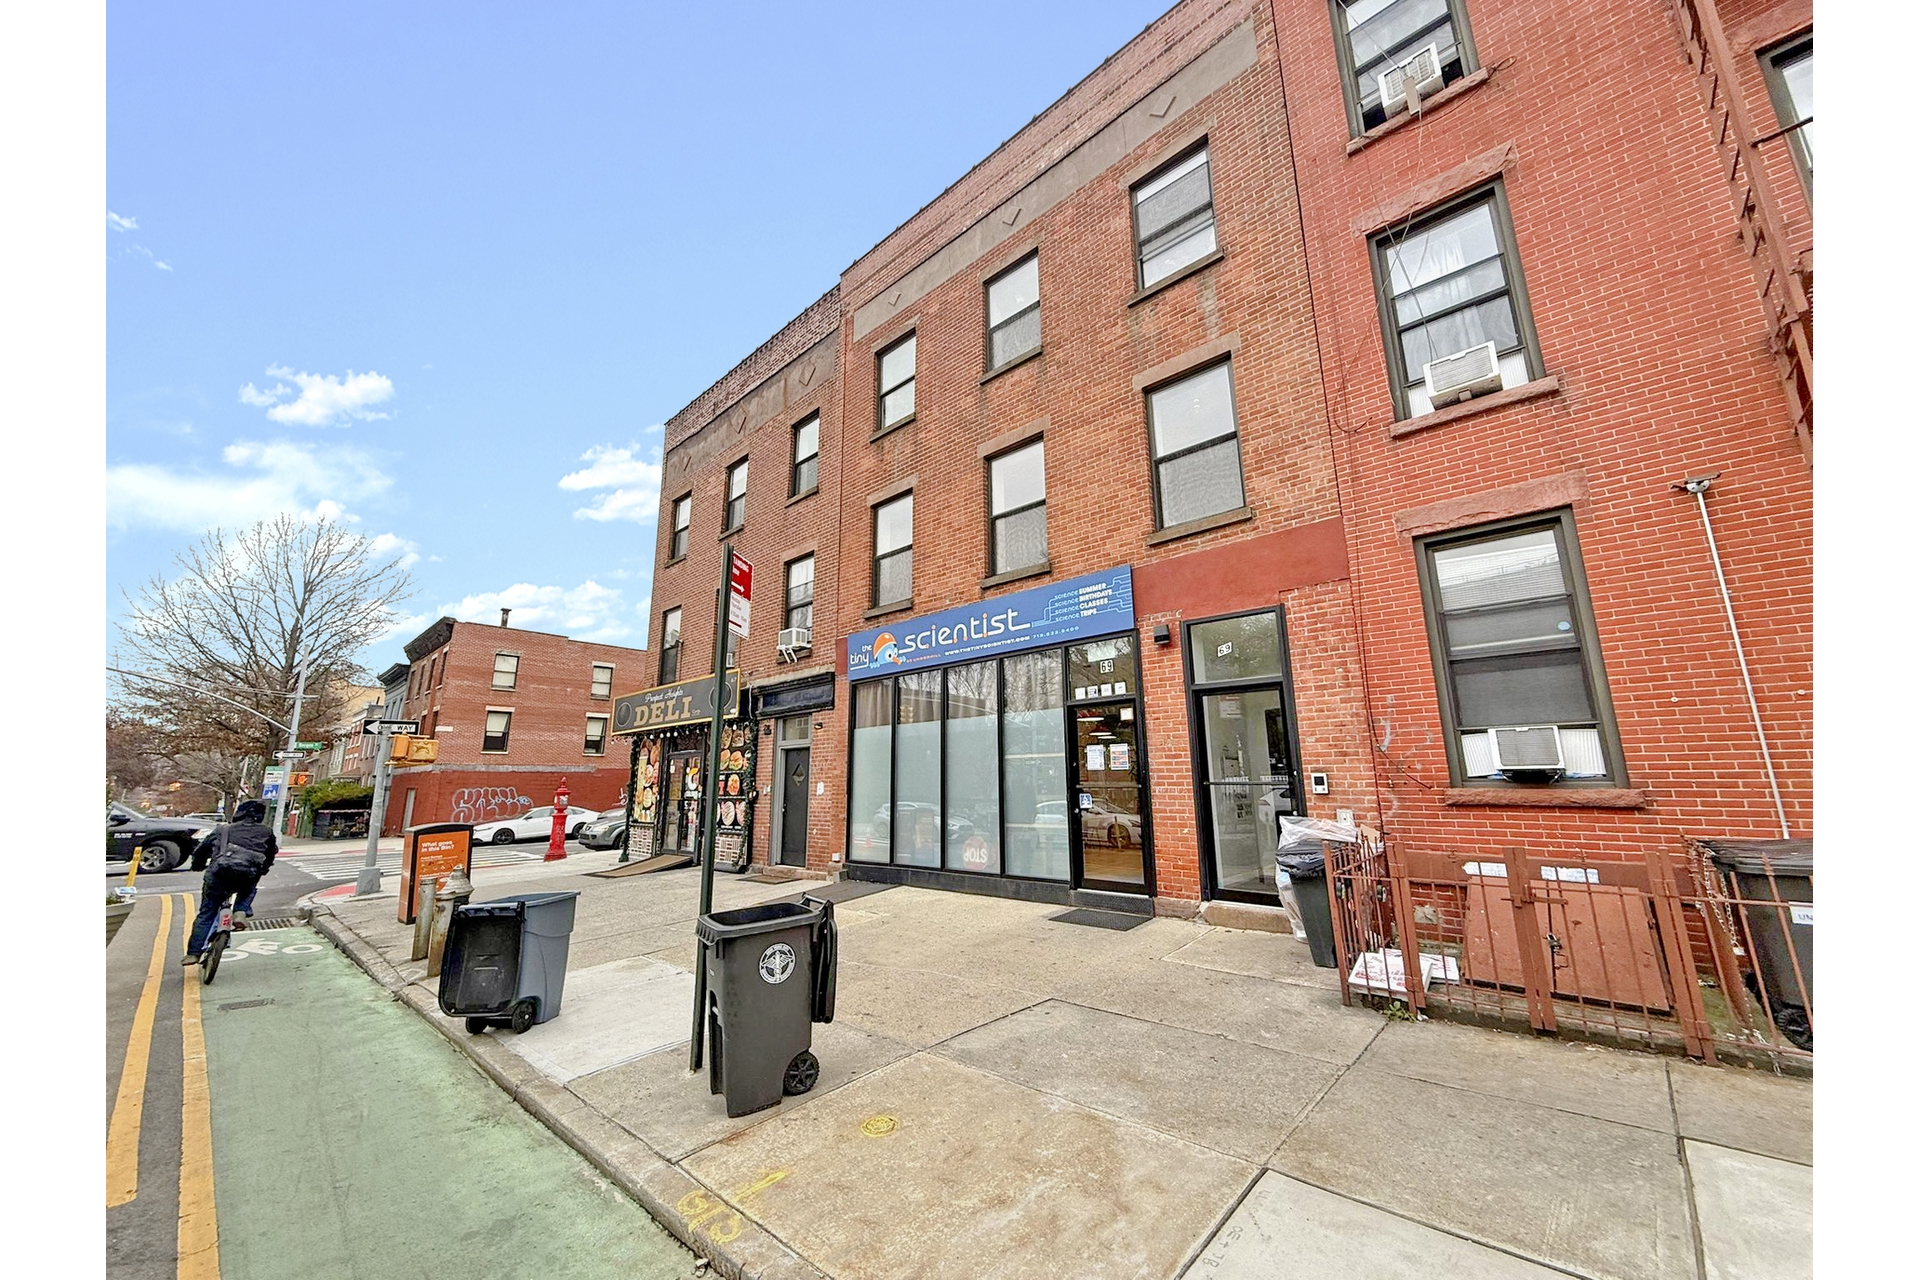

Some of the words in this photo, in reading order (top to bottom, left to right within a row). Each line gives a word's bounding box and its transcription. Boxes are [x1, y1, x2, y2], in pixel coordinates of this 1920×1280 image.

[733, 555, 749, 573] TANDING
[1054, 590, 1078, 600] science
[1079, 582, 1107, 594] SUMMER
[1055, 597, 1079, 607] science
[1079, 588, 1113, 602] BIRTHDAYS
[1055, 605, 1079, 615] science
[1080, 597, 1109, 609] CLASSES
[1055, 612, 1080, 622] science
[1080, 608, 1097, 618] TRIPS
[850, 652, 869, 671] tiny
[899, 608, 1031, 654] scientist
[862, 644, 872, 652] the
[1219, 644, 1231, 655] 69
[1101, 660, 1112, 672] 69
[633, 696, 692, 727] DELI
[397, 724, 414, 732] WAY
[963, 847, 988, 864] STOP
